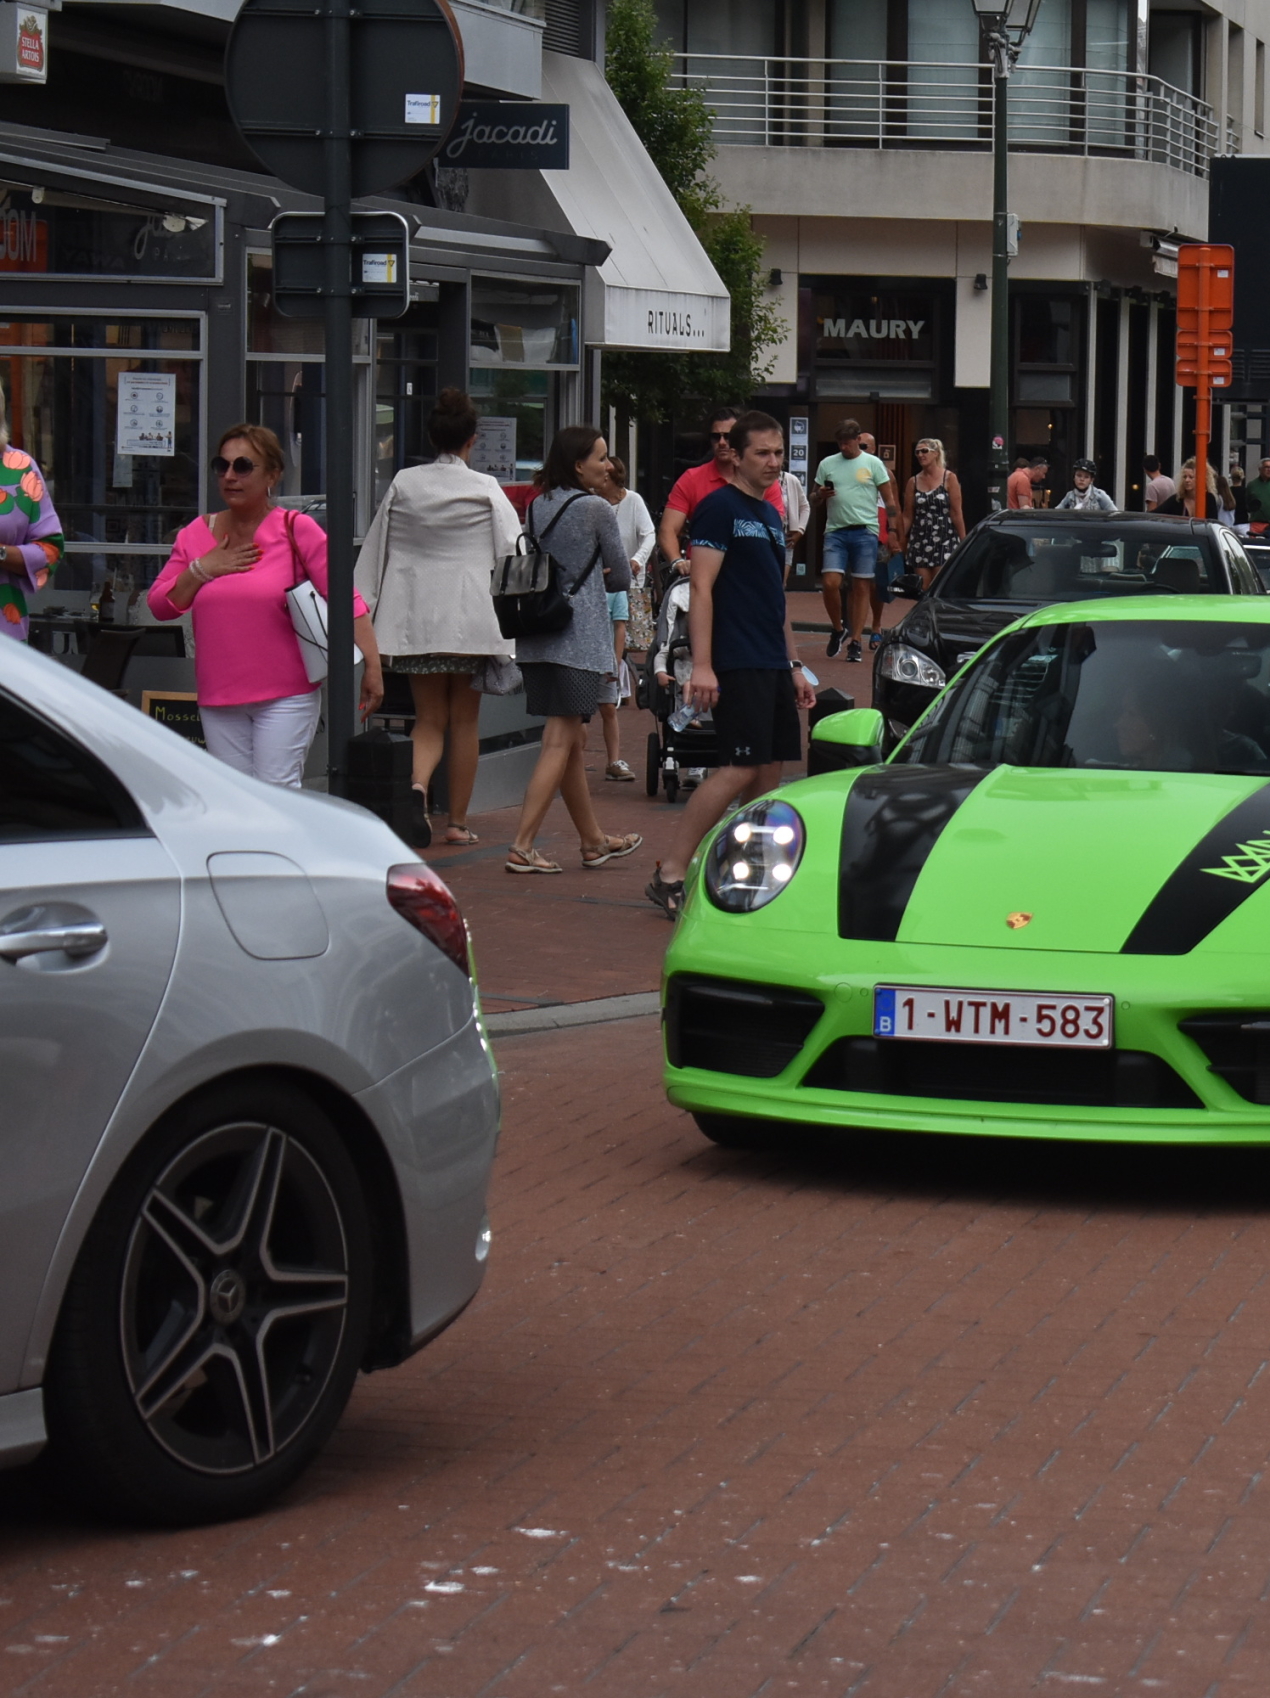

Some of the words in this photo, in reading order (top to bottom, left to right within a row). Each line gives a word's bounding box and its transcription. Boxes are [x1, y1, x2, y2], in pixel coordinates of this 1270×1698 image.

[21, 37, 39, 50] STELLA
[22, 49, 39, 62] ARTOIS
[446, 112, 557, 158] jacadi
[823, 318, 925, 339] MAURY
[879, 1016, 892, 1032] B
[902, 998, 1105, 1040] 1-WTM-583
